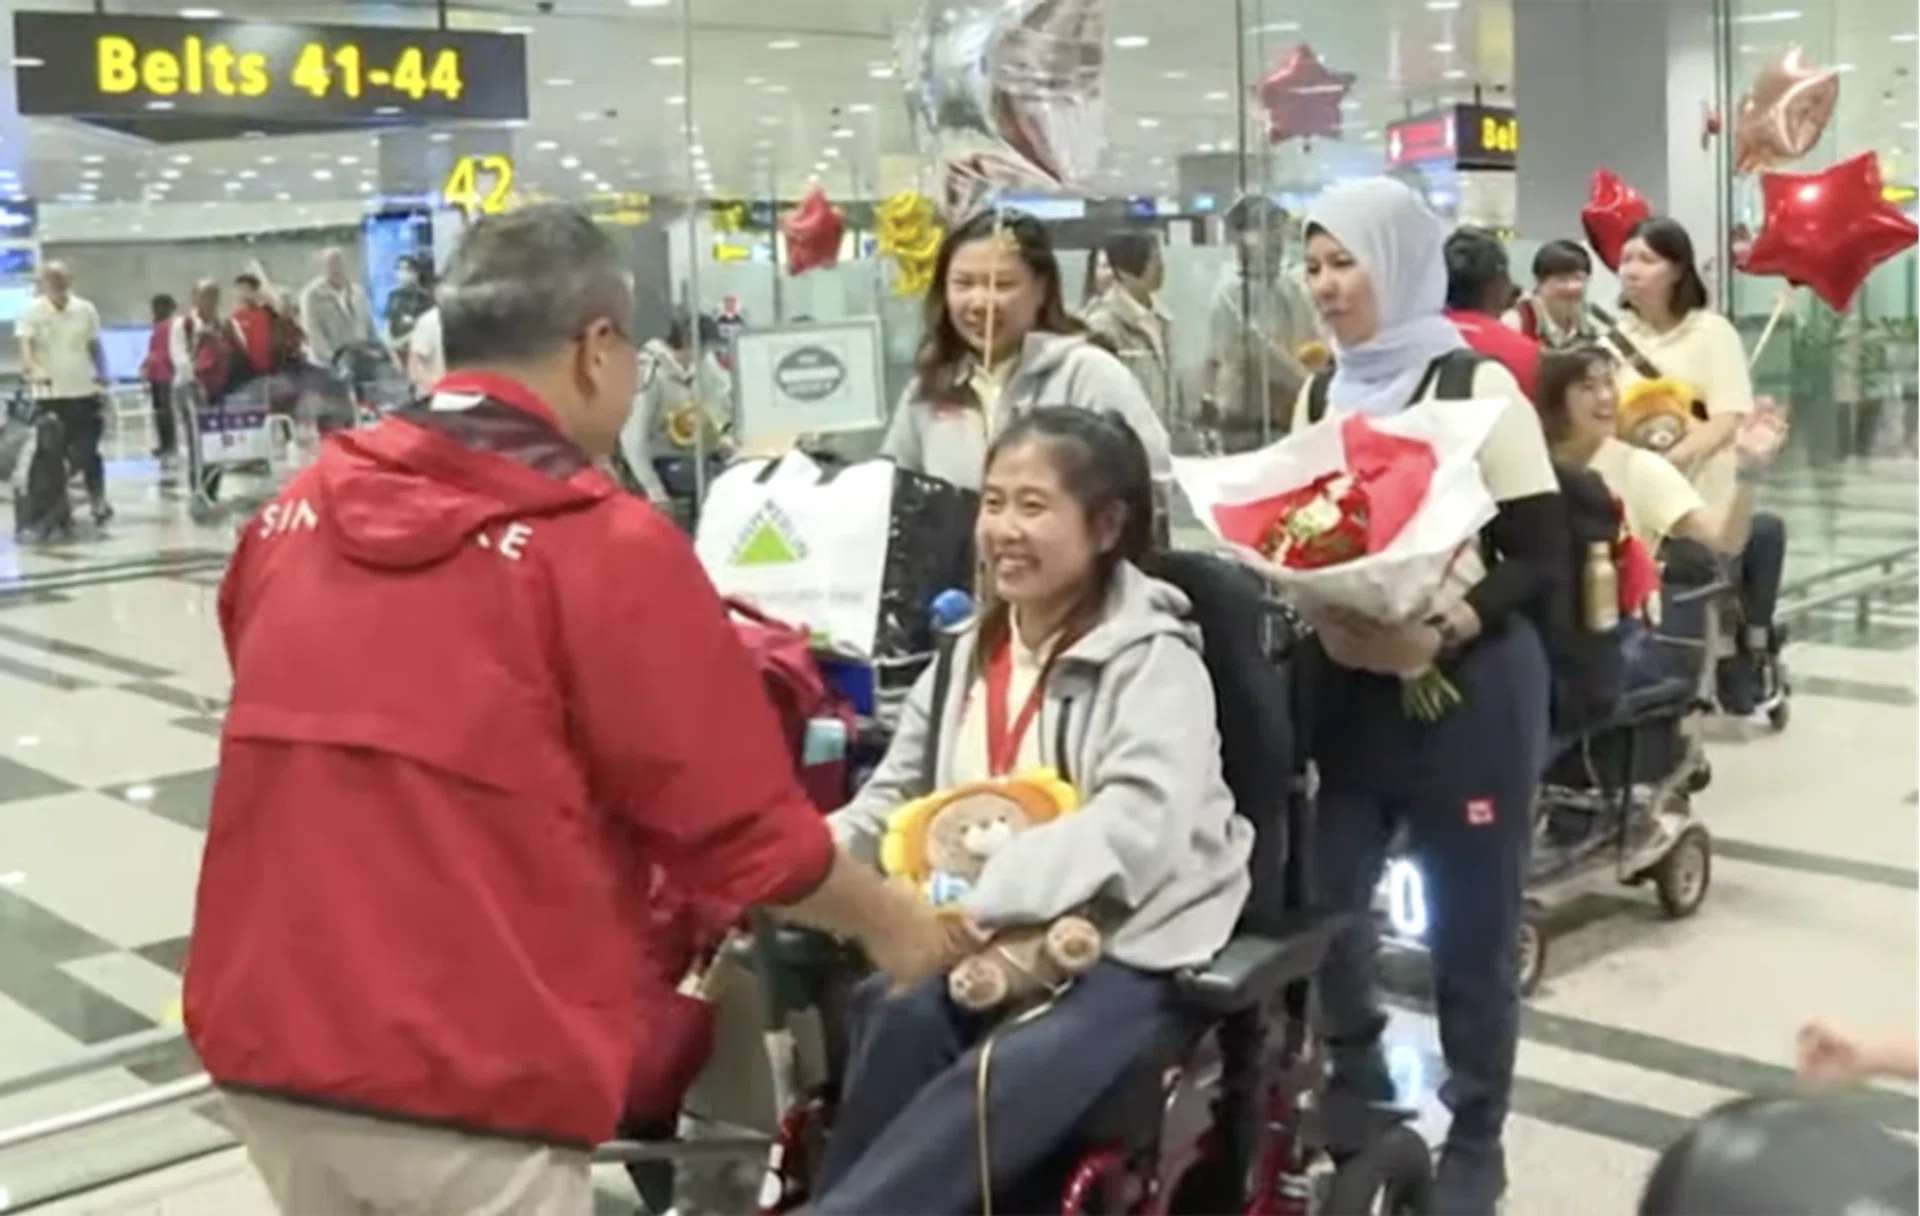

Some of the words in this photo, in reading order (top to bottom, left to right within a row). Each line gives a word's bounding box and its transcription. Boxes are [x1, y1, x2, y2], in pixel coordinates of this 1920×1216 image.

[97, 35, 269, 97] Belts
[291, 43, 463, 99] 41-44
[444, 154, 513, 216] 42
